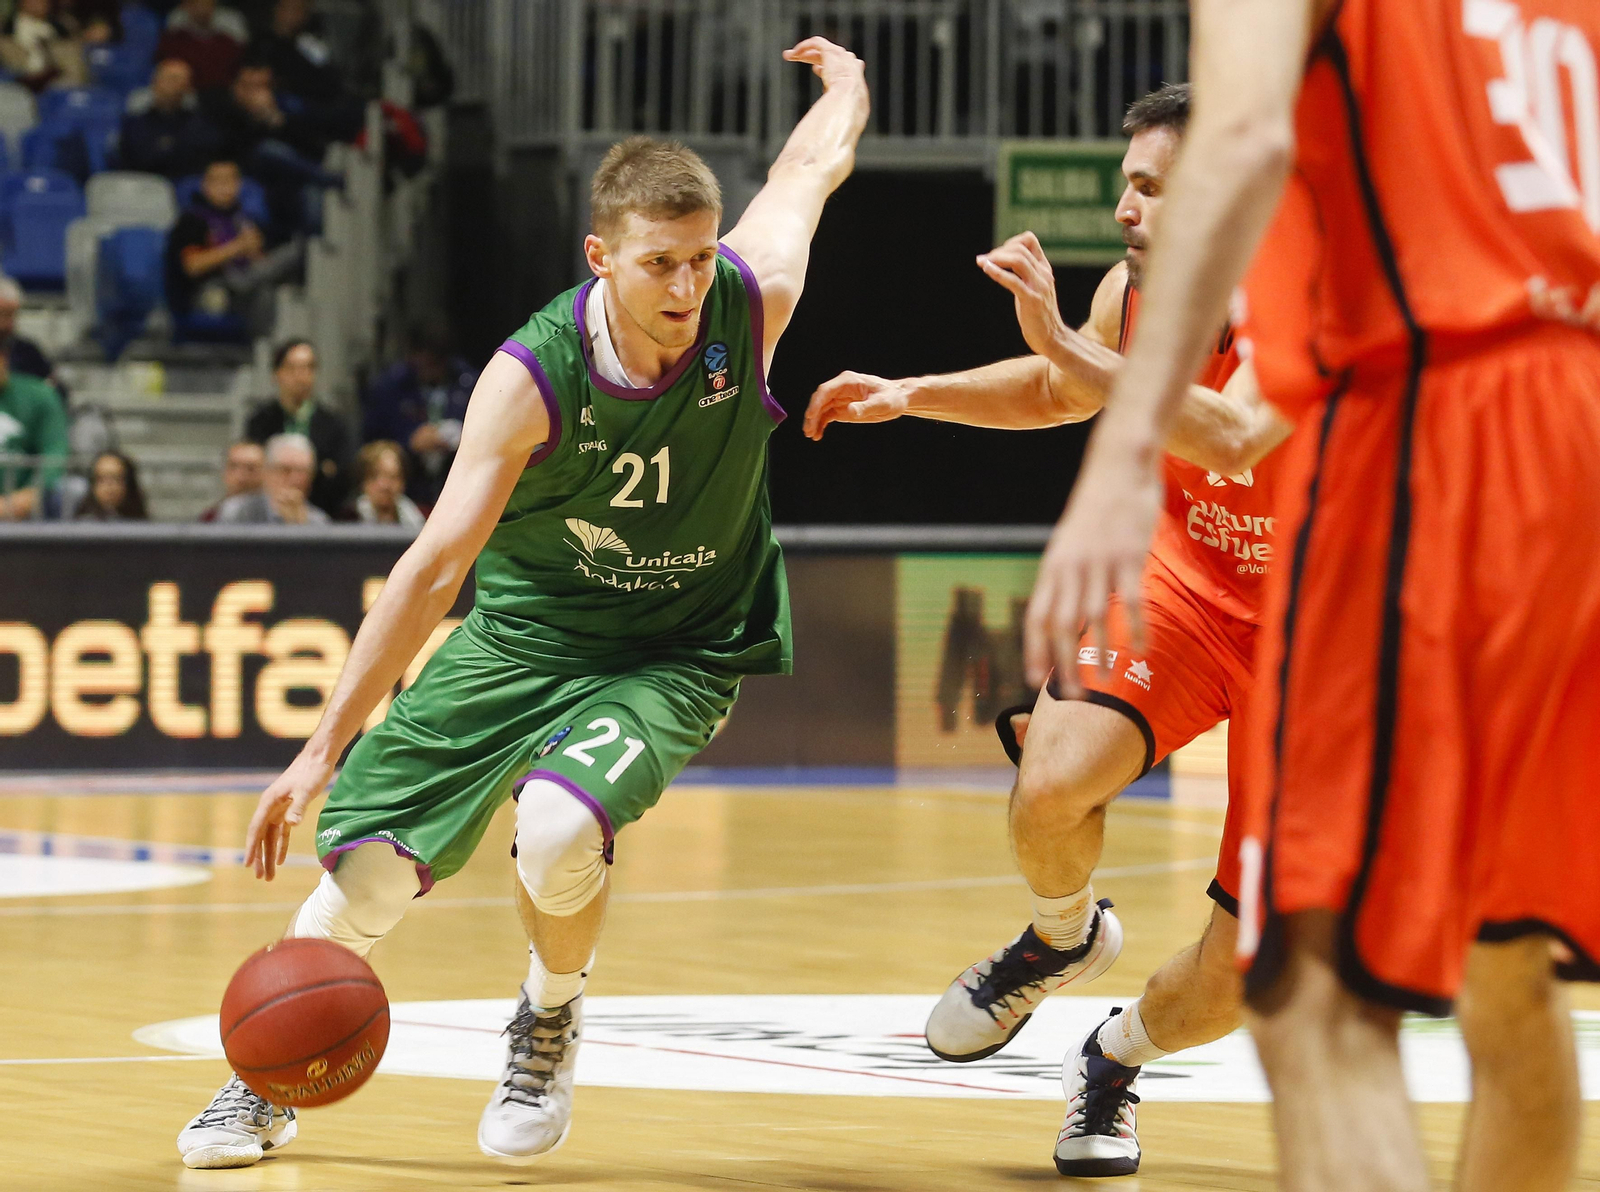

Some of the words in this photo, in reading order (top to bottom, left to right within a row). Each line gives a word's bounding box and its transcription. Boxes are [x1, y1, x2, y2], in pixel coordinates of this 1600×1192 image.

[1461, 0, 1600, 236] 30
[609, 446, 670, 508] 21
[625, 545, 717, 568] Unicaja
[1187, 504, 1274, 562] Esfue
[1236, 563, 1270, 575] @Val
[0, 577, 465, 739] etfa
[1124, 671, 1151, 692] luanvi
[562, 716, 647, 785] 21
